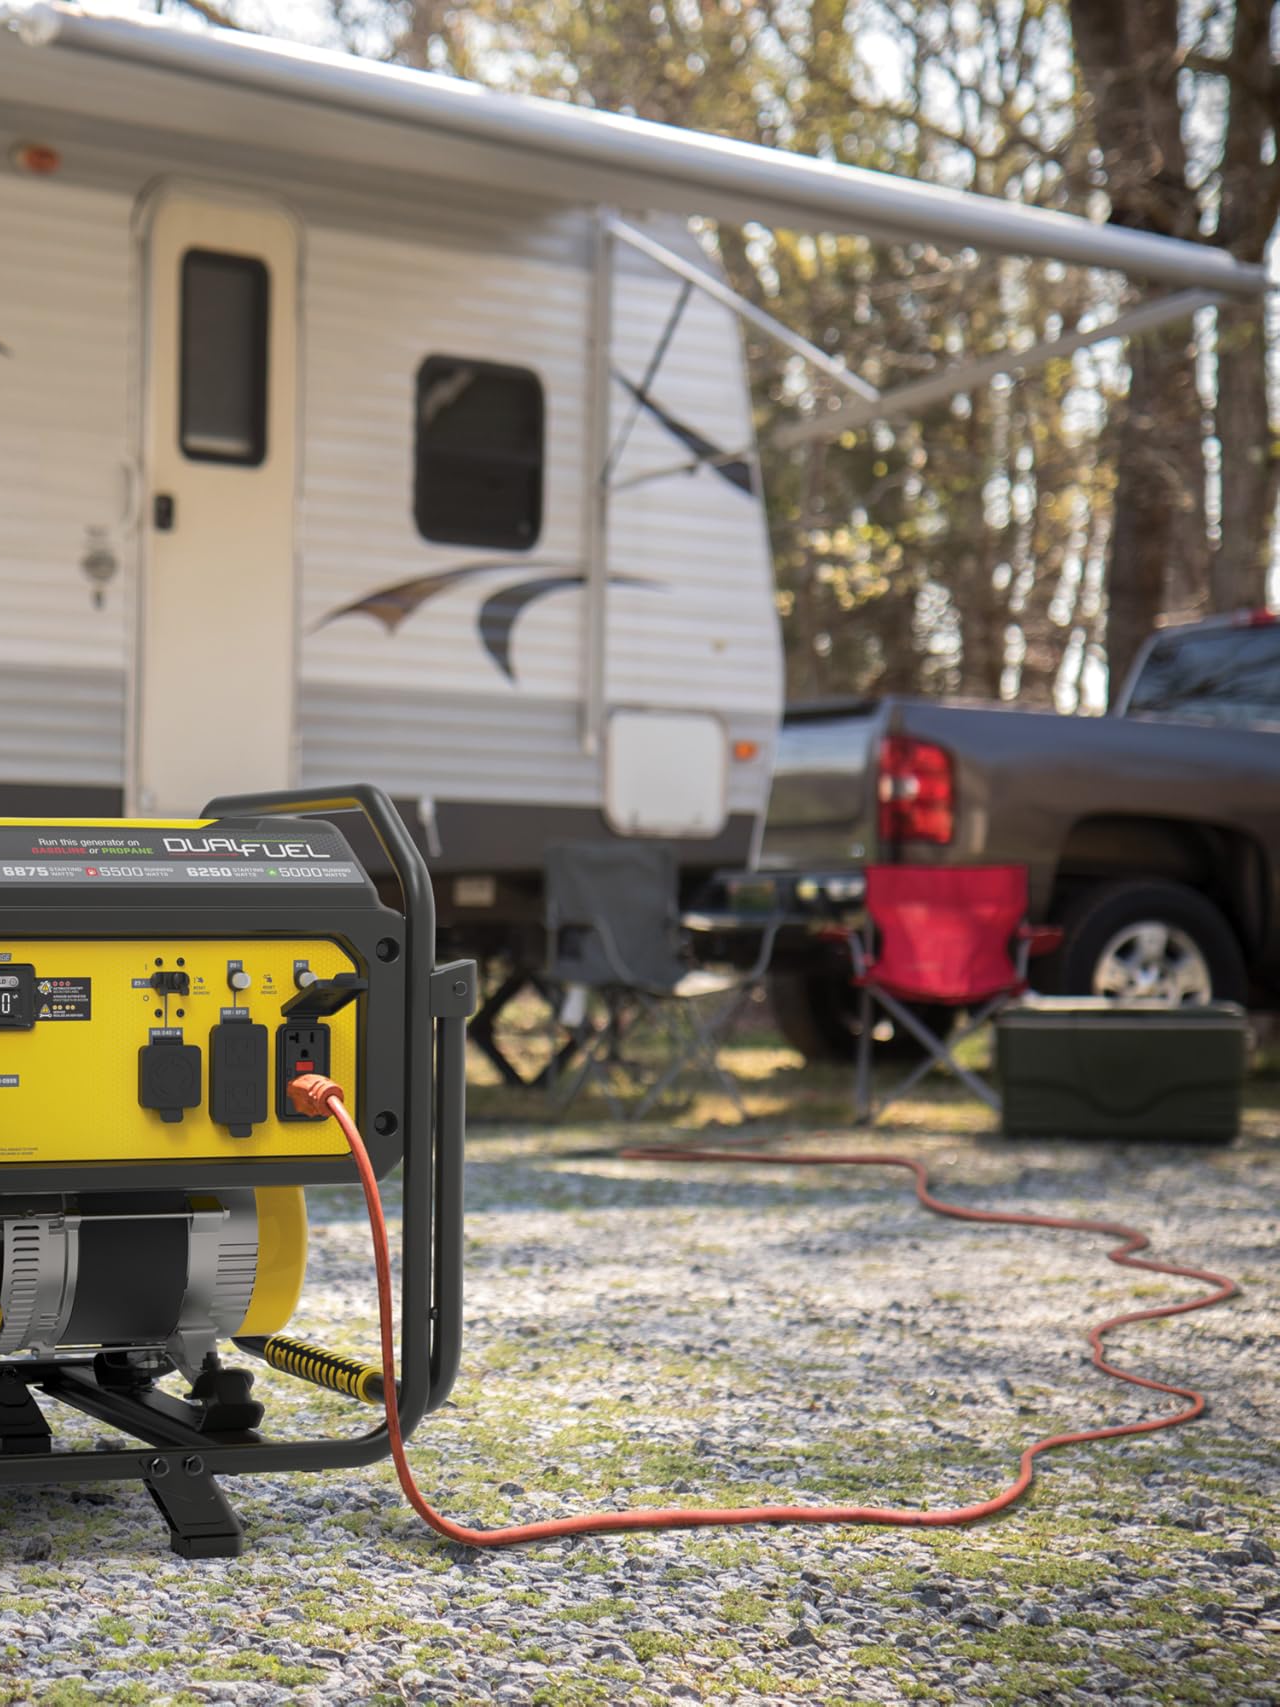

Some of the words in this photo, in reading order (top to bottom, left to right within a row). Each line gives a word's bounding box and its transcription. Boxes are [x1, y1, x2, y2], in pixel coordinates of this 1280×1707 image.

[38, 838, 58, 847] Run
[60, 838, 78, 847] this
[80, 838, 125, 848] generator
[89, 847, 99, 855] or
[101, 847, 154, 855] PROPANE
[2, 866, 49, 877] 6875
[99, 866, 144, 877] 5500
[186, 867, 232, 877] 6250
[278, 867, 322, 877] 5000
